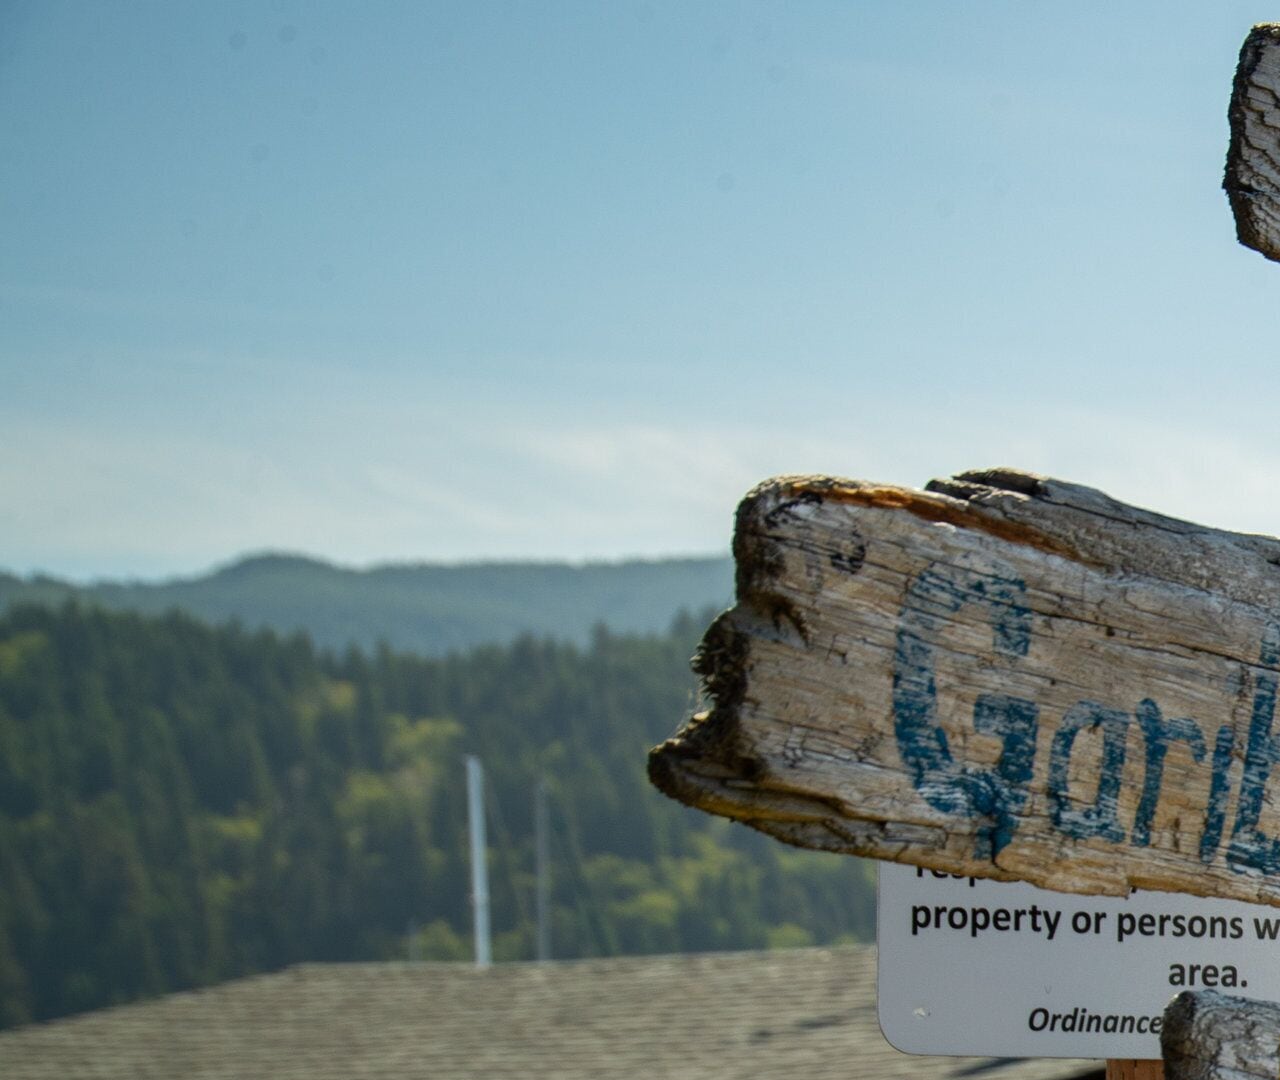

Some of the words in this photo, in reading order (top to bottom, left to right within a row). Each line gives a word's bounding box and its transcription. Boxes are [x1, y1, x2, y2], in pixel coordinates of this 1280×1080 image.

[911, 903, 1062, 942] property
[1071, 910, 1107, 936] or
[1116, 911, 1244, 943] persons
[1167, 962, 1249, 989] area.
[1028, 1006, 1164, 1036] Ordinance
